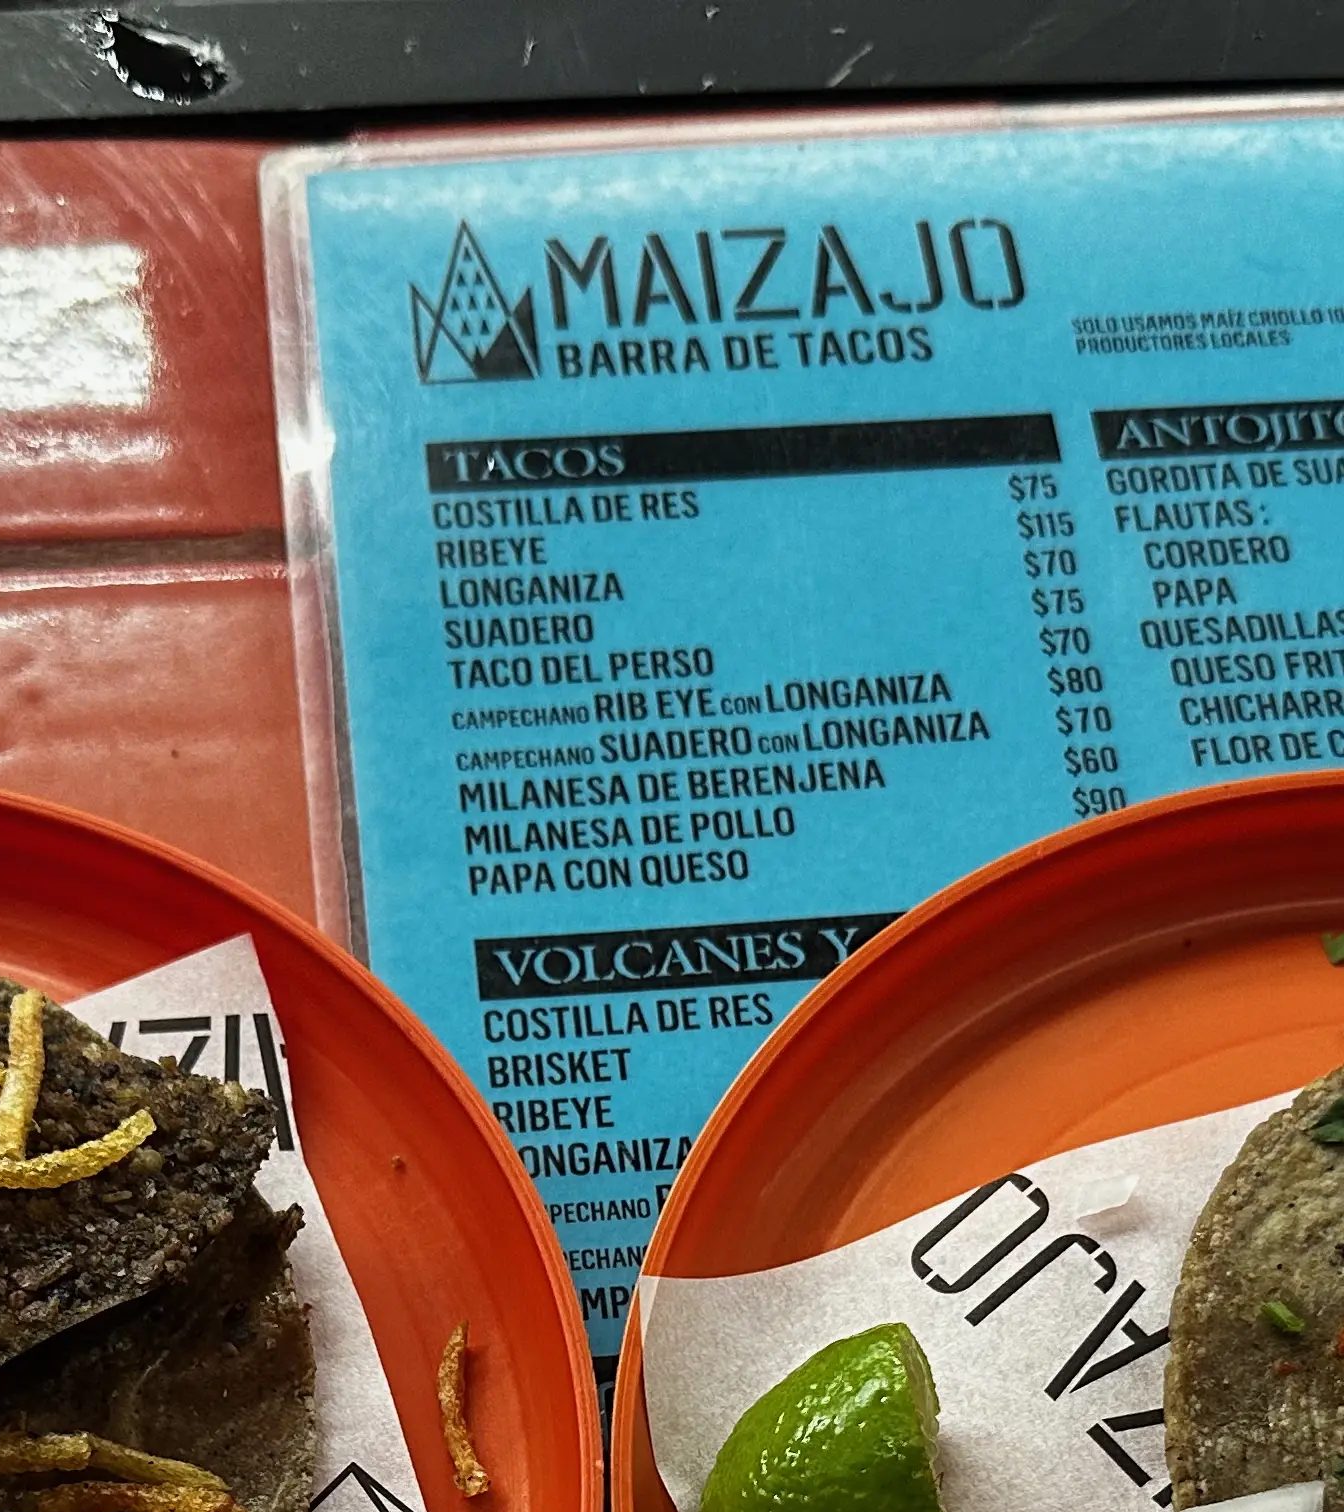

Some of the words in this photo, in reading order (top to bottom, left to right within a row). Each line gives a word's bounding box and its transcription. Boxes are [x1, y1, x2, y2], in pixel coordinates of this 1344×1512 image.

[546, 217, 1027, 331] MAIZAJO
[1071, 315, 1117, 335] SOLO
[1121, 311, 1197, 333] USAMOS
[1248, 306, 1324, 328] CRIOLLO
[1075, 332, 1206, 355] PRODUCTORES
[556, 335, 710, 379] BARRA
[722, 332, 779, 371] DE
[789, 325, 934, 367] TACOS
[442, 444, 626, 483] TACOS
[1106, 461, 1241, 496] GORDITA
[1246, 459, 1288, 488] DE
[432, 495, 585, 530] COSTILLA
[591, 493, 633, 523] DE
[639, 490, 700, 520] RES
[1008, 473, 1058, 503] $75
[436, 536, 547, 569] RIBEYE
[1016, 511, 1074, 541] $115
[1143, 535, 1291, 570] CORDERO
[439, 572, 624, 609] LONGANIZA
[1023, 549, 1077, 579] $70
[1152, 576, 1238, 609] PAPA
[444, 613, 594, 649] SUADERO
[1031, 587, 1085, 618] $75
[447, 656, 533, 689] TACO
[541, 653, 603, 685] DEL
[608, 647, 715, 682] PERSO
[1039, 626, 1091, 658] $70
[1170, 652, 1277, 688] QUESO
[451, 705, 590, 730] CAMPECHANO
[593, 690, 649, 723] RIB
[655, 687, 717, 720] EYE
[764, 672, 952, 713] LONGANIZA
[1047, 665, 1104, 698] $80
[455, 746, 595, 771] CAMPECHANO
[599, 726, 753, 764] SUADERO
[802, 710, 991, 752] LONGANIZA
[1055, 705, 1113, 737] $70
[1191, 734, 1275, 768] FLOR
[1278, 730, 1323, 761] DE
[459, 773, 631, 813] MILANESA
[637, 770, 681, 804] DE
[687, 757, 886, 800] BERENJENA
[1063, 746, 1119, 778] $60
[464, 816, 634, 856] MILANESA
[640, 813, 684, 846] DE
[689, 806, 796, 843] POLLO
[1072, 786, 1130, 820] $90
[468, 861, 557, 896] PAPA
[563, 856, 633, 891] CON
[639, 848, 749, 888] QUESO
[494, 931, 806, 986] VOLCANES
[819, 928, 858, 965] Y
[483, 1001, 649, 1044] COSTILLA
[655, 997, 702, 1033] DE
[708, 992, 776, 1029] RES
[487, 1047, 632, 1090] BRISKET
[494, 1096, 615, 1133] RIBEYE
[519, 1136, 692, 1179] ONGANIZA
[545, 1198, 651, 1226] PECHANO
